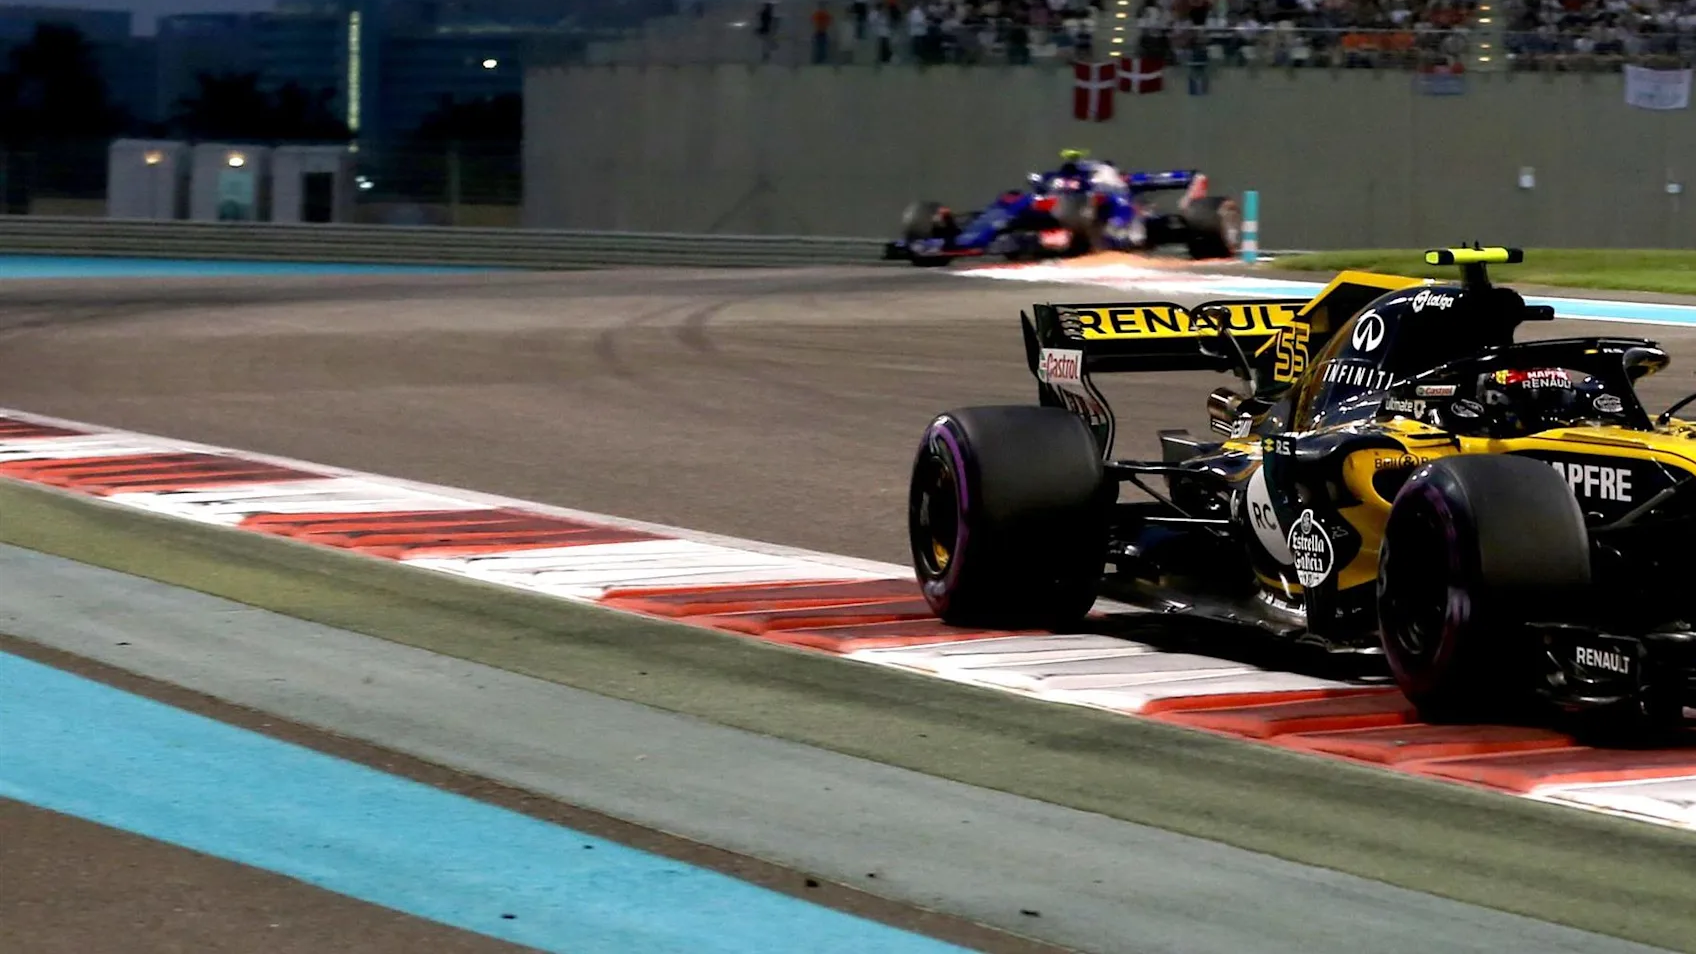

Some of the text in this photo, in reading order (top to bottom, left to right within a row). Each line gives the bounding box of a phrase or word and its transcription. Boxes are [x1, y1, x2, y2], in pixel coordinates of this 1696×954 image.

[1274, 321, 1310, 383] 55
[1047, 352, 1078, 381] Castrol
[1323, 364, 1394, 390] INFINITI
[1522, 377, 1572, 389] RENAULT
[1552, 461, 1632, 502] PFRE
[1292, 531, 1325, 553] Estrella
[1576, 646, 1630, 674] RENAULT
